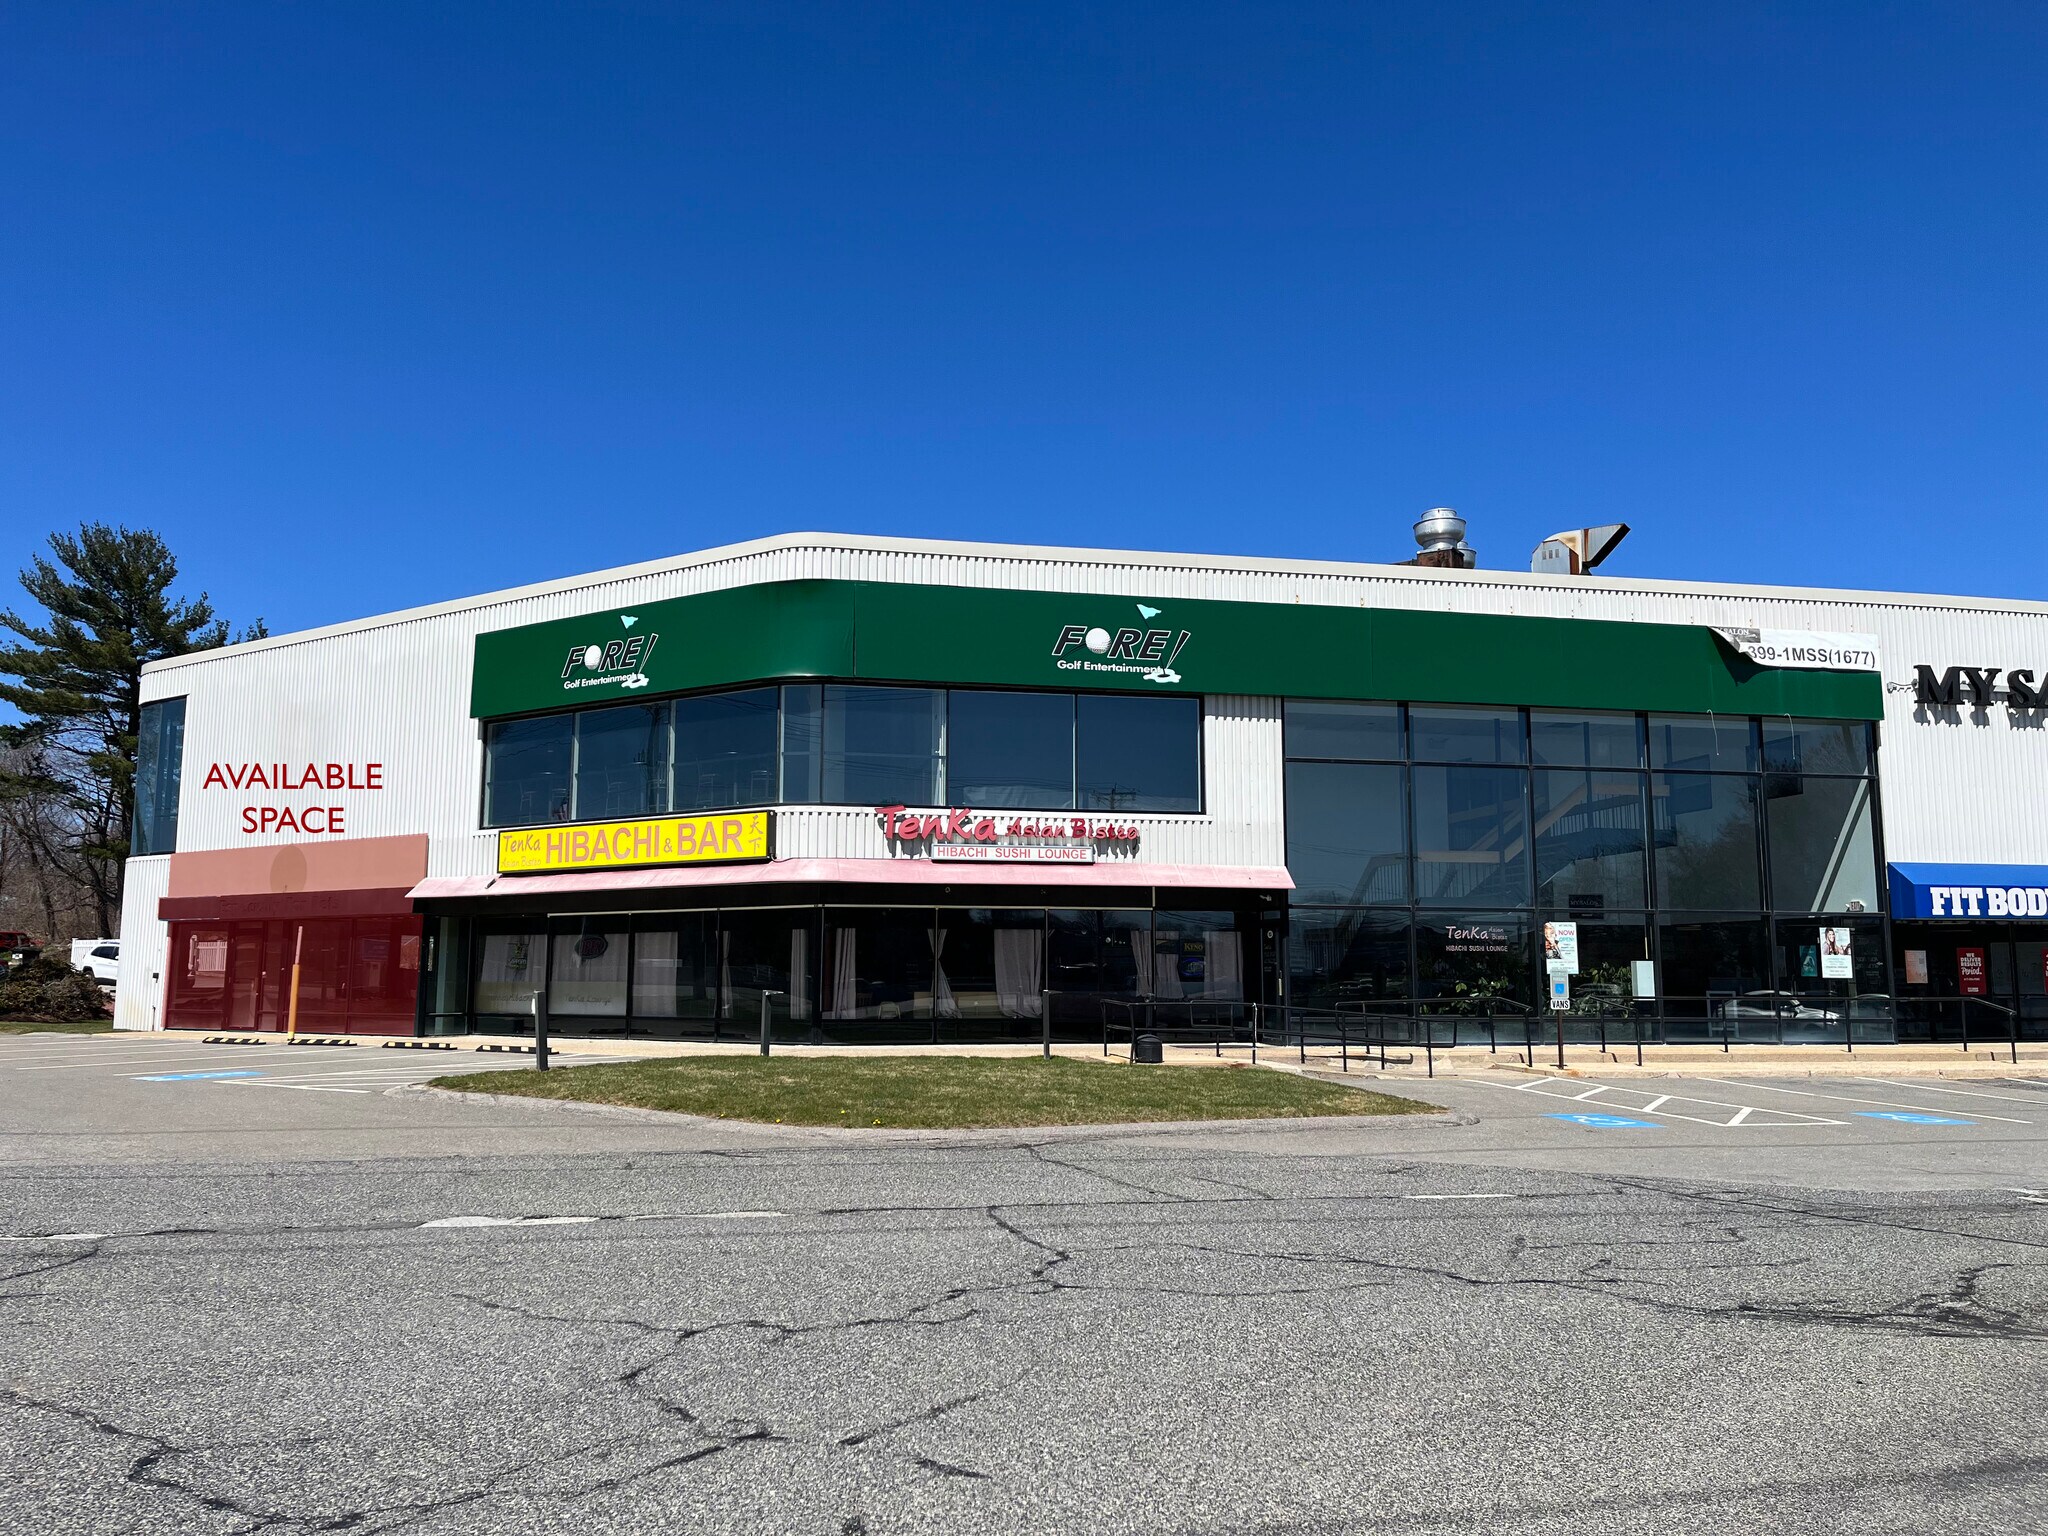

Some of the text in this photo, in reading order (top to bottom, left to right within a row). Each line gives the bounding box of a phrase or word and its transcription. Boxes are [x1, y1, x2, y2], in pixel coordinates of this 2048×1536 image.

[561, 633, 659, 678] FORE!
[1052, 625, 1191, 669] FORE!
[1057, 660, 1164, 674] Golf Entertainment
[563, 672, 637, 690] Golf Entertainment
[874, 804, 1140, 842] TenKa Asian Bistro
[503, 834, 541, 853] TenKa
[545, 819, 744, 864] HIBACHI & BAR
[936, 846, 1087, 860] HIBACHI SUSHI LOUNGE
[1930, 886, 2048, 917] FIT BOD
[1445, 925, 1489, 940] TenKa
[1551, 1000, 1569, 1009] VANS
